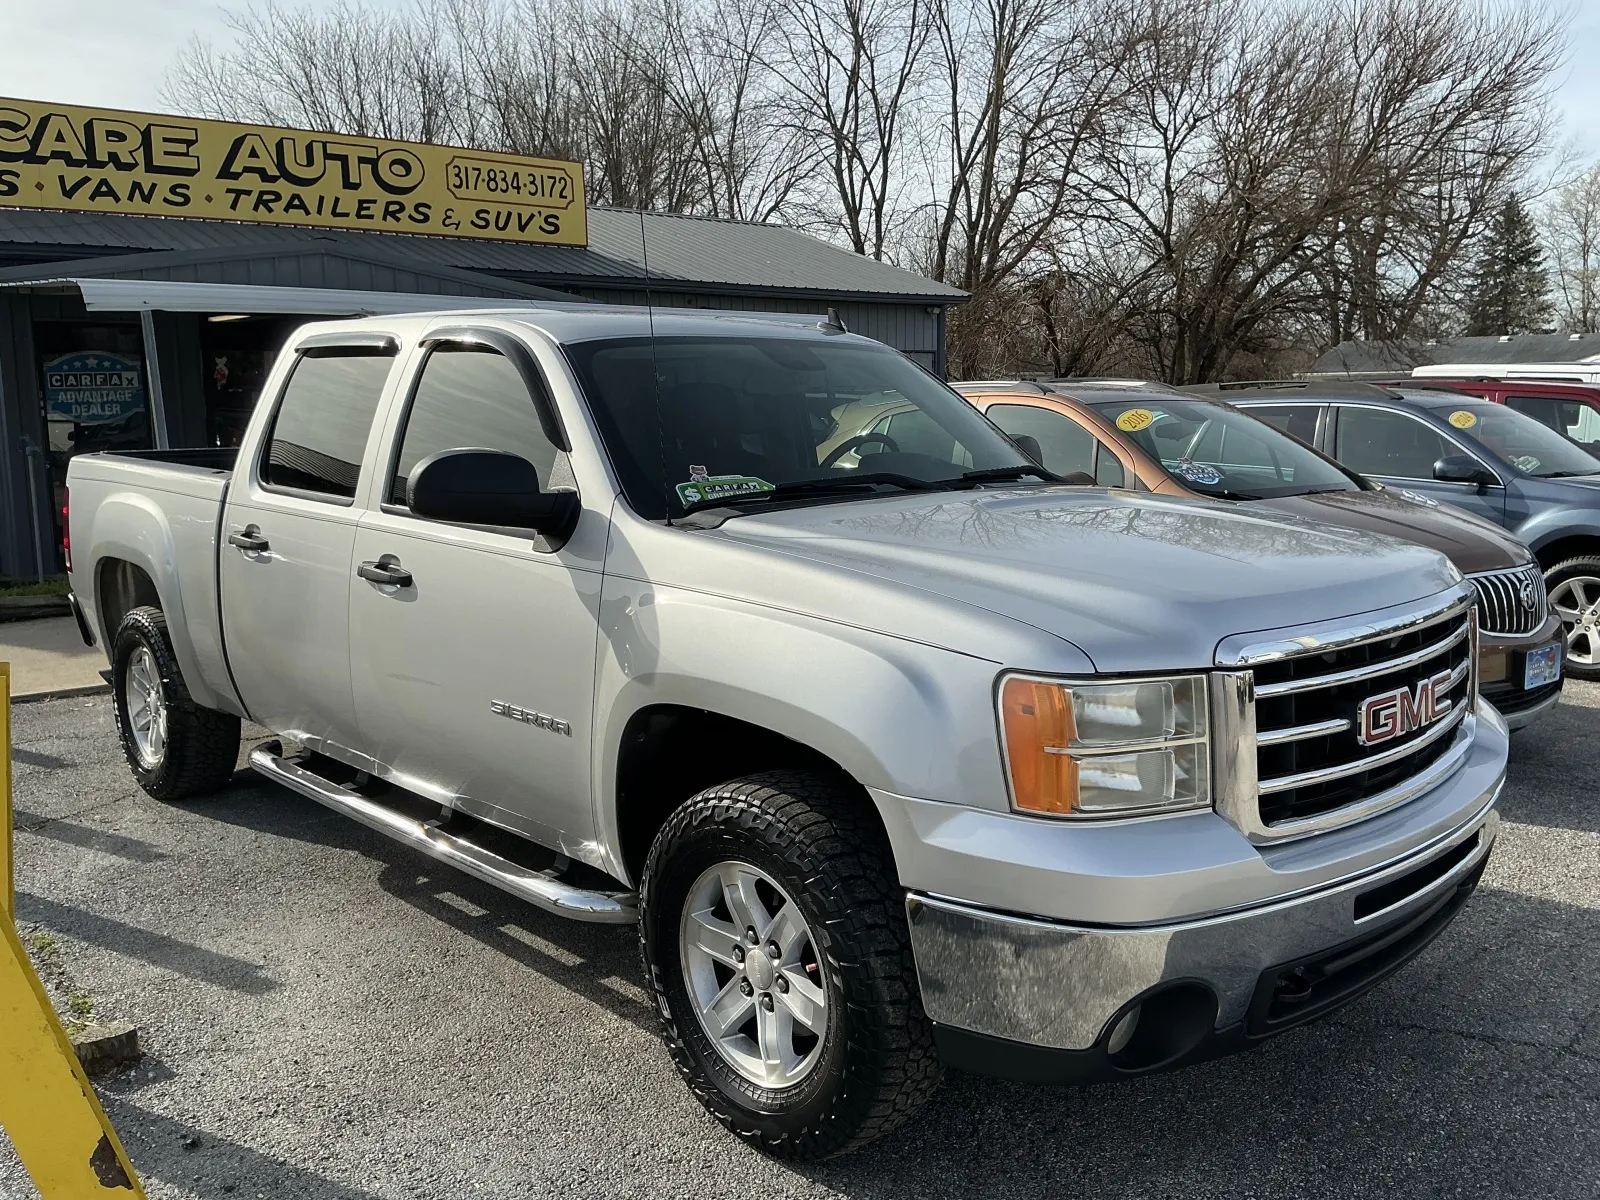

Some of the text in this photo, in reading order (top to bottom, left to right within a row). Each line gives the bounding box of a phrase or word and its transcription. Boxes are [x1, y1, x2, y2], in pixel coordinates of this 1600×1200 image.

[0, 107, 425, 195] CARE AUTO
[58, 174, 192, 207] VANS
[224, 187, 431, 224] TRAILERS
[441, 208, 461, 231] &
[470, 208, 561, 235] SUV'S
[51, 374, 135, 387] CARFAX
[58, 389, 133, 403] ADVANTAGE
[72, 403, 121, 416] DEALER
[1122, 411, 1149, 430] 2016
[704, 482, 761, 493] CARFAX
[1357, 668, 1452, 746] GMC
[490, 699, 572, 738] SIERRA
